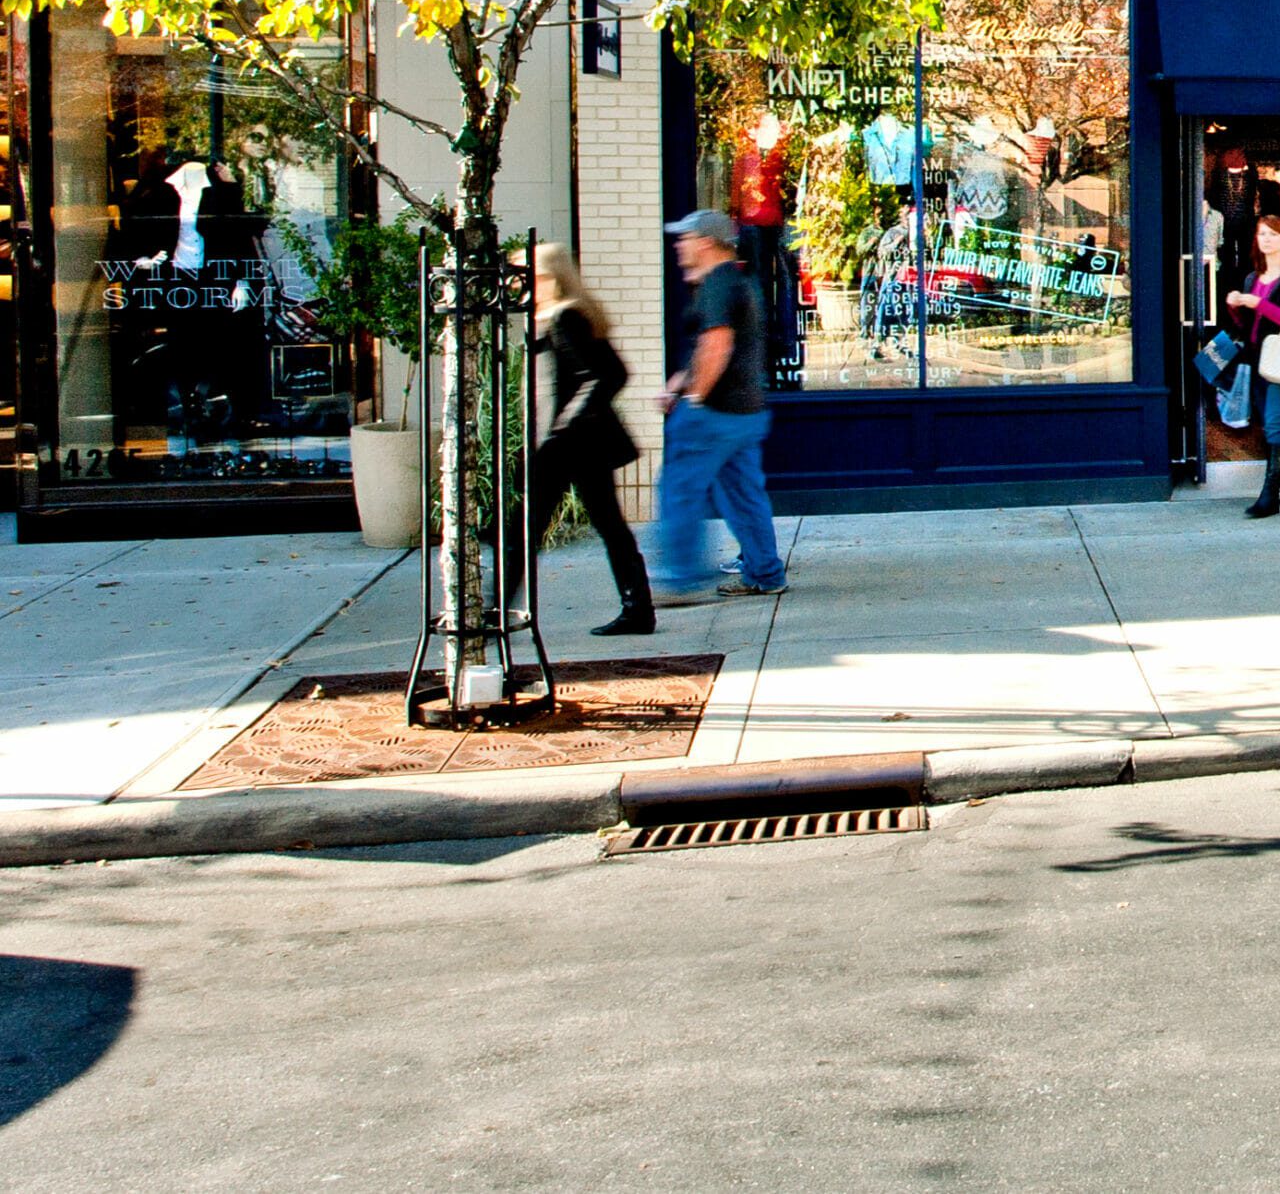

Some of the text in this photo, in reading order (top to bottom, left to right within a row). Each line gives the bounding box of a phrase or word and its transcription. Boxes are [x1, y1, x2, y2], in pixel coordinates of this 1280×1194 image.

[964, 17, 1086, 46] Madewell
[983, 240, 1010, 249] NOW
[94, 258, 312, 282] WINTER
[943, 247, 978, 275] YOUR
[978, 255, 1006, 281] NEW
[1006, 261, 1066, 290] FAVORITE
[1064, 270, 1106, 298] JEANS
[102, 285, 306, 310] STORMS
[1001, 289, 1035, 302] 2010
